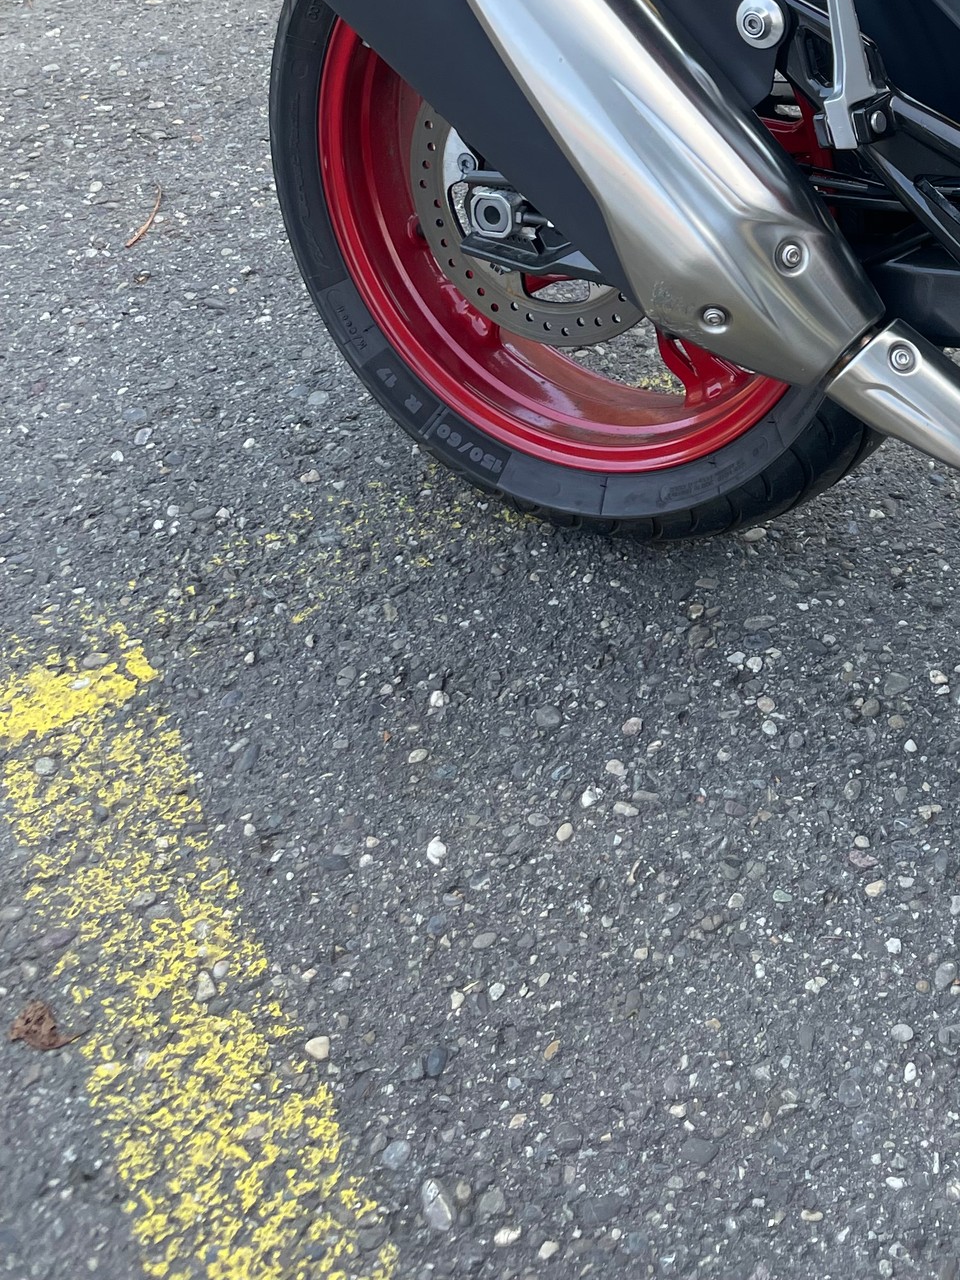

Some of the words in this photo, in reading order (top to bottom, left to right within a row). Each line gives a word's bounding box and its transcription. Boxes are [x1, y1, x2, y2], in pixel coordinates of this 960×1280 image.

[376, 368, 397, 388] 17
[404, 394, 423, 414] R
[436, 424, 503, 472] 150/60
